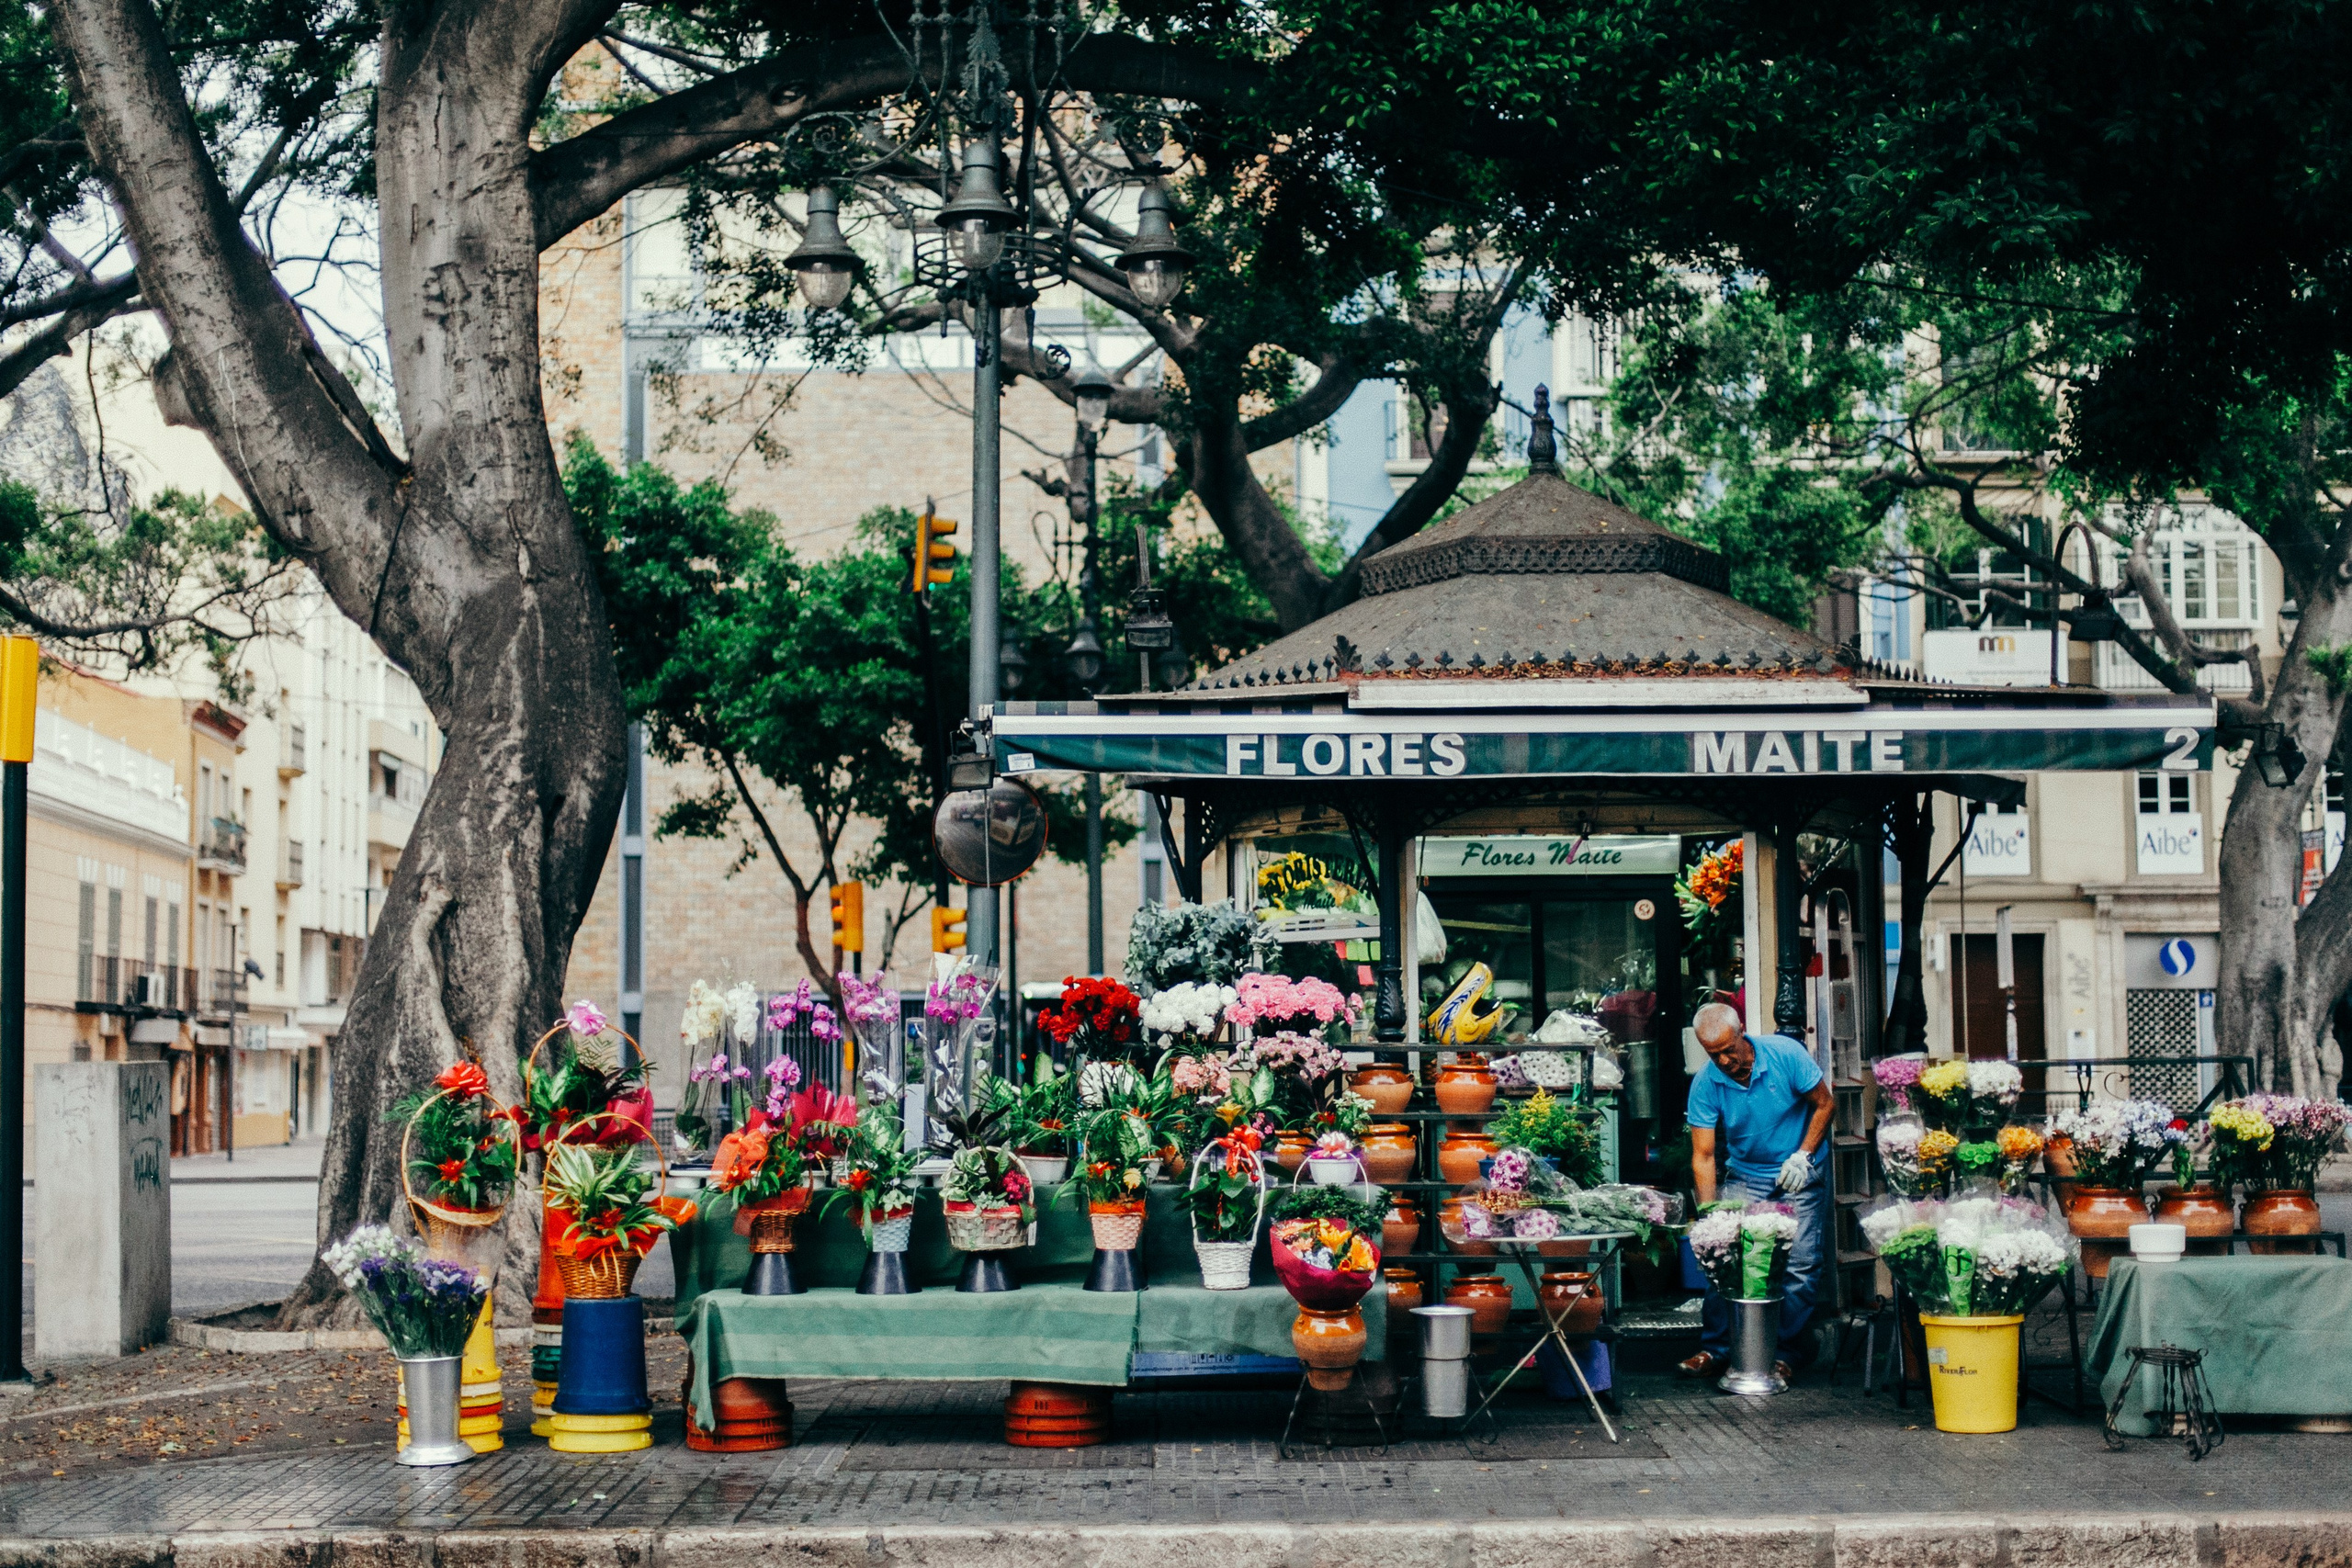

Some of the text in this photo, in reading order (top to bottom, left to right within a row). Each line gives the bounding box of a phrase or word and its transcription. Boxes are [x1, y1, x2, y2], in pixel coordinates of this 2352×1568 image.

[1226, 727, 2200, 776] FLORES MAITE 2
[1461, 841, 1623, 867] Flores Maite
[1969, 828, 2018, 858] Aibe
[2141, 828, 2190, 856] Aibe
